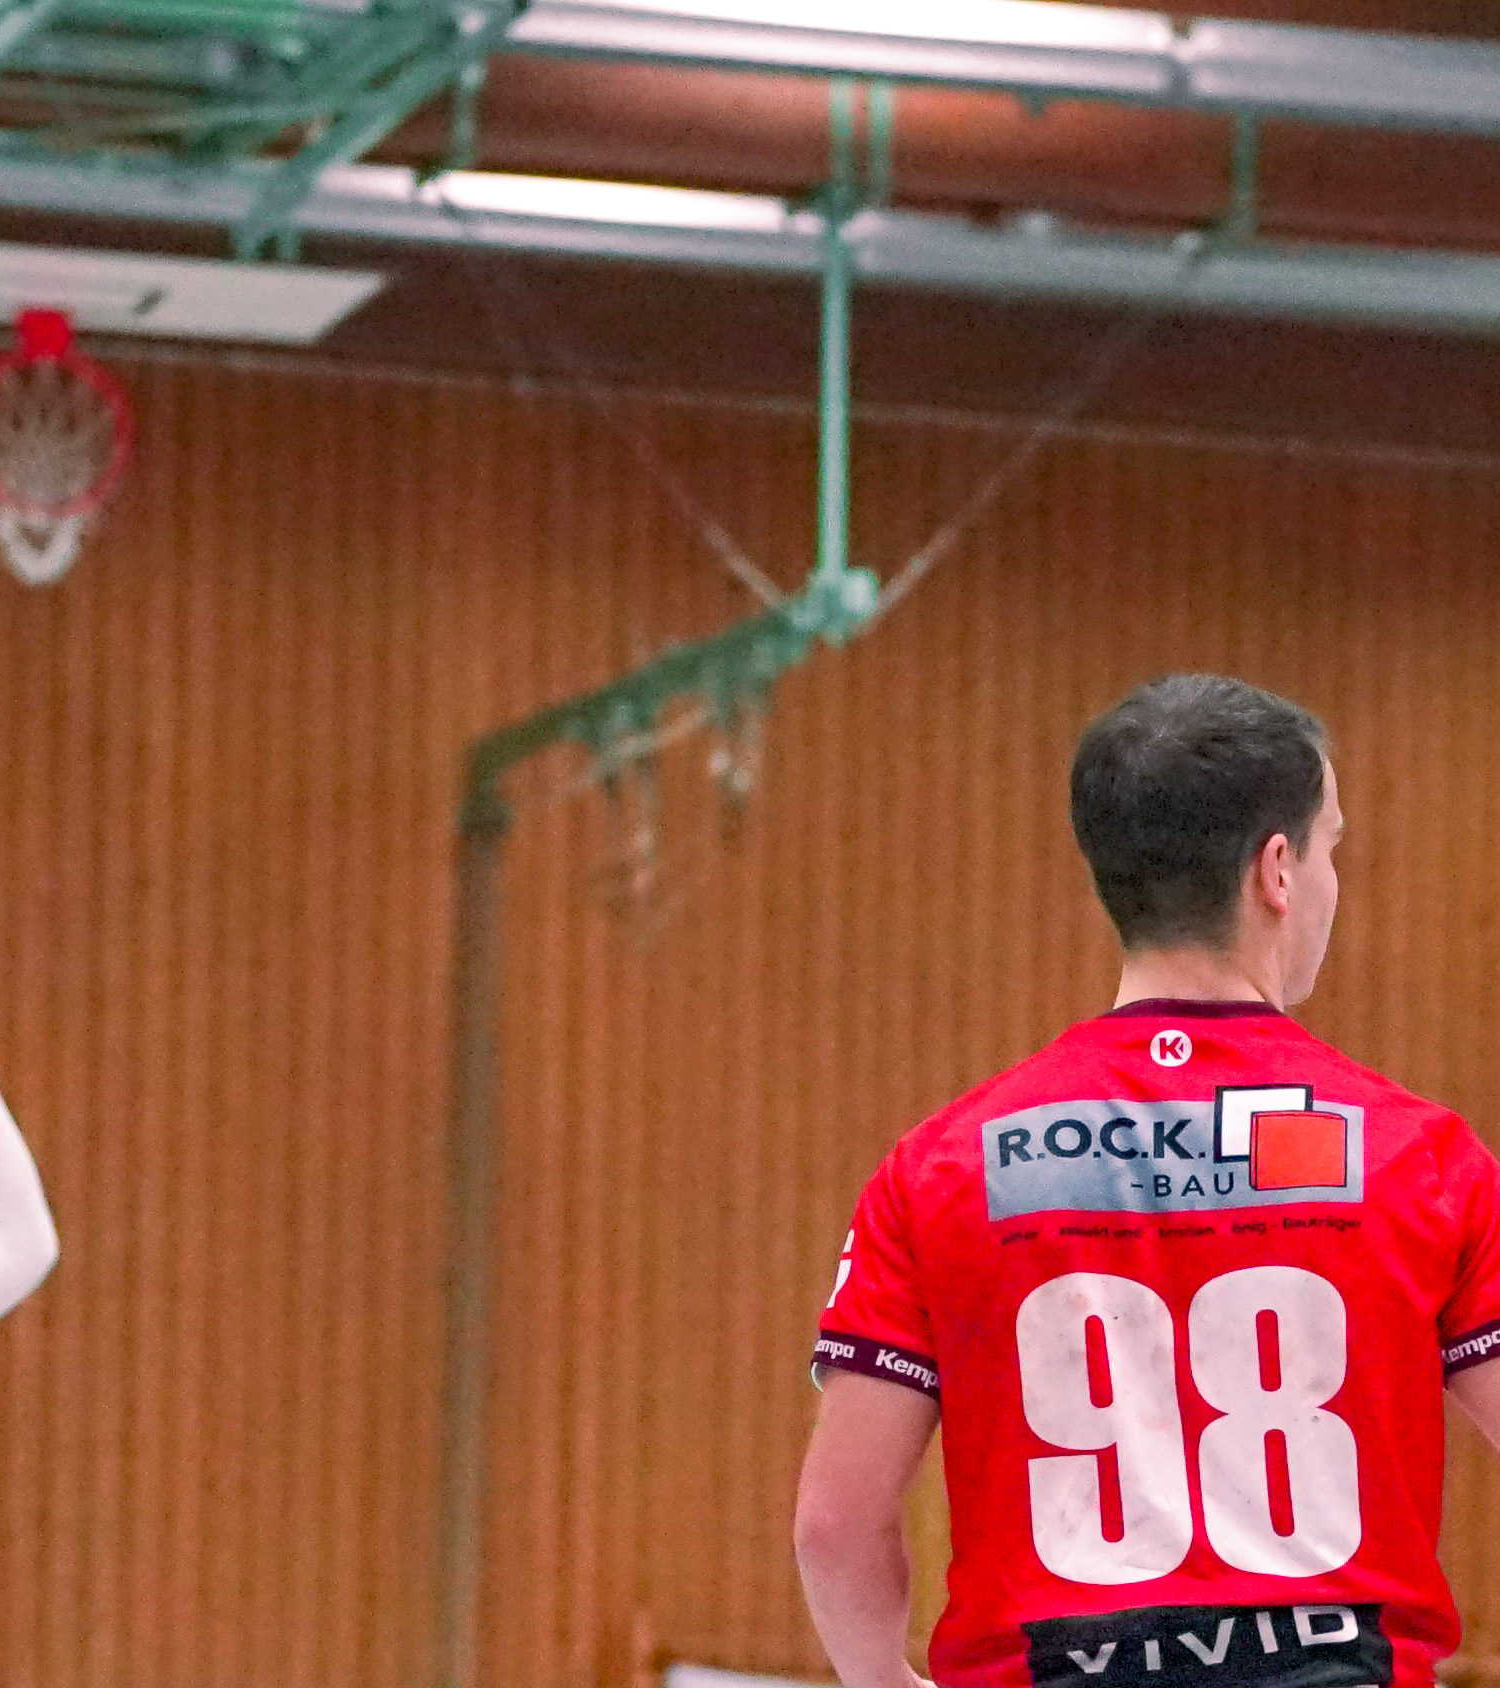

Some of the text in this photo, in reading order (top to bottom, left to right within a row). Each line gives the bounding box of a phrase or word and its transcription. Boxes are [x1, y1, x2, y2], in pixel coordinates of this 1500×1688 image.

[996, 1115, 1208, 1169] R.O.C.K.
[1015, 1264, 1364, 1587] 98
[1066, 1604, 1361, 1676] VIVID
